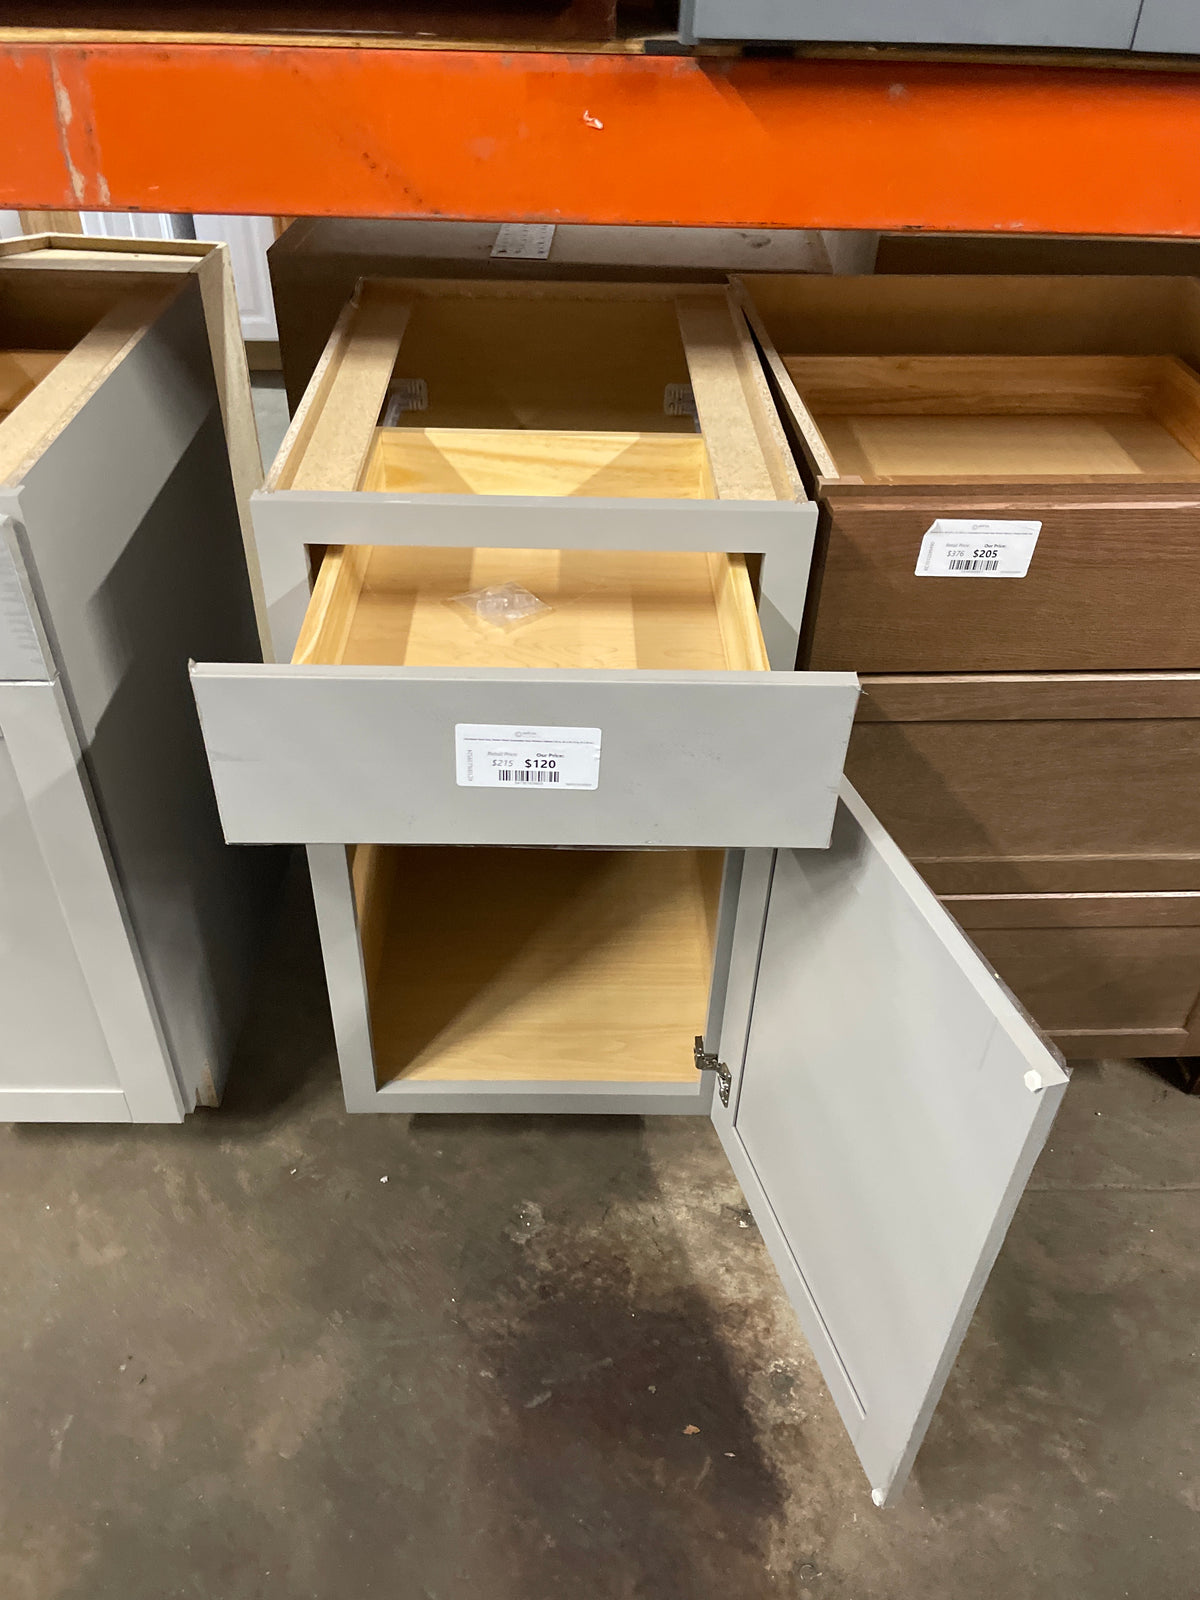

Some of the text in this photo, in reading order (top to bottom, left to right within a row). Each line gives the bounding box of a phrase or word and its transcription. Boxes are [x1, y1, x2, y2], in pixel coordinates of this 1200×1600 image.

[973, 549, 998, 558] $205
[491, 759, 514, 767] $215
[524, 758, 556, 769] $120
